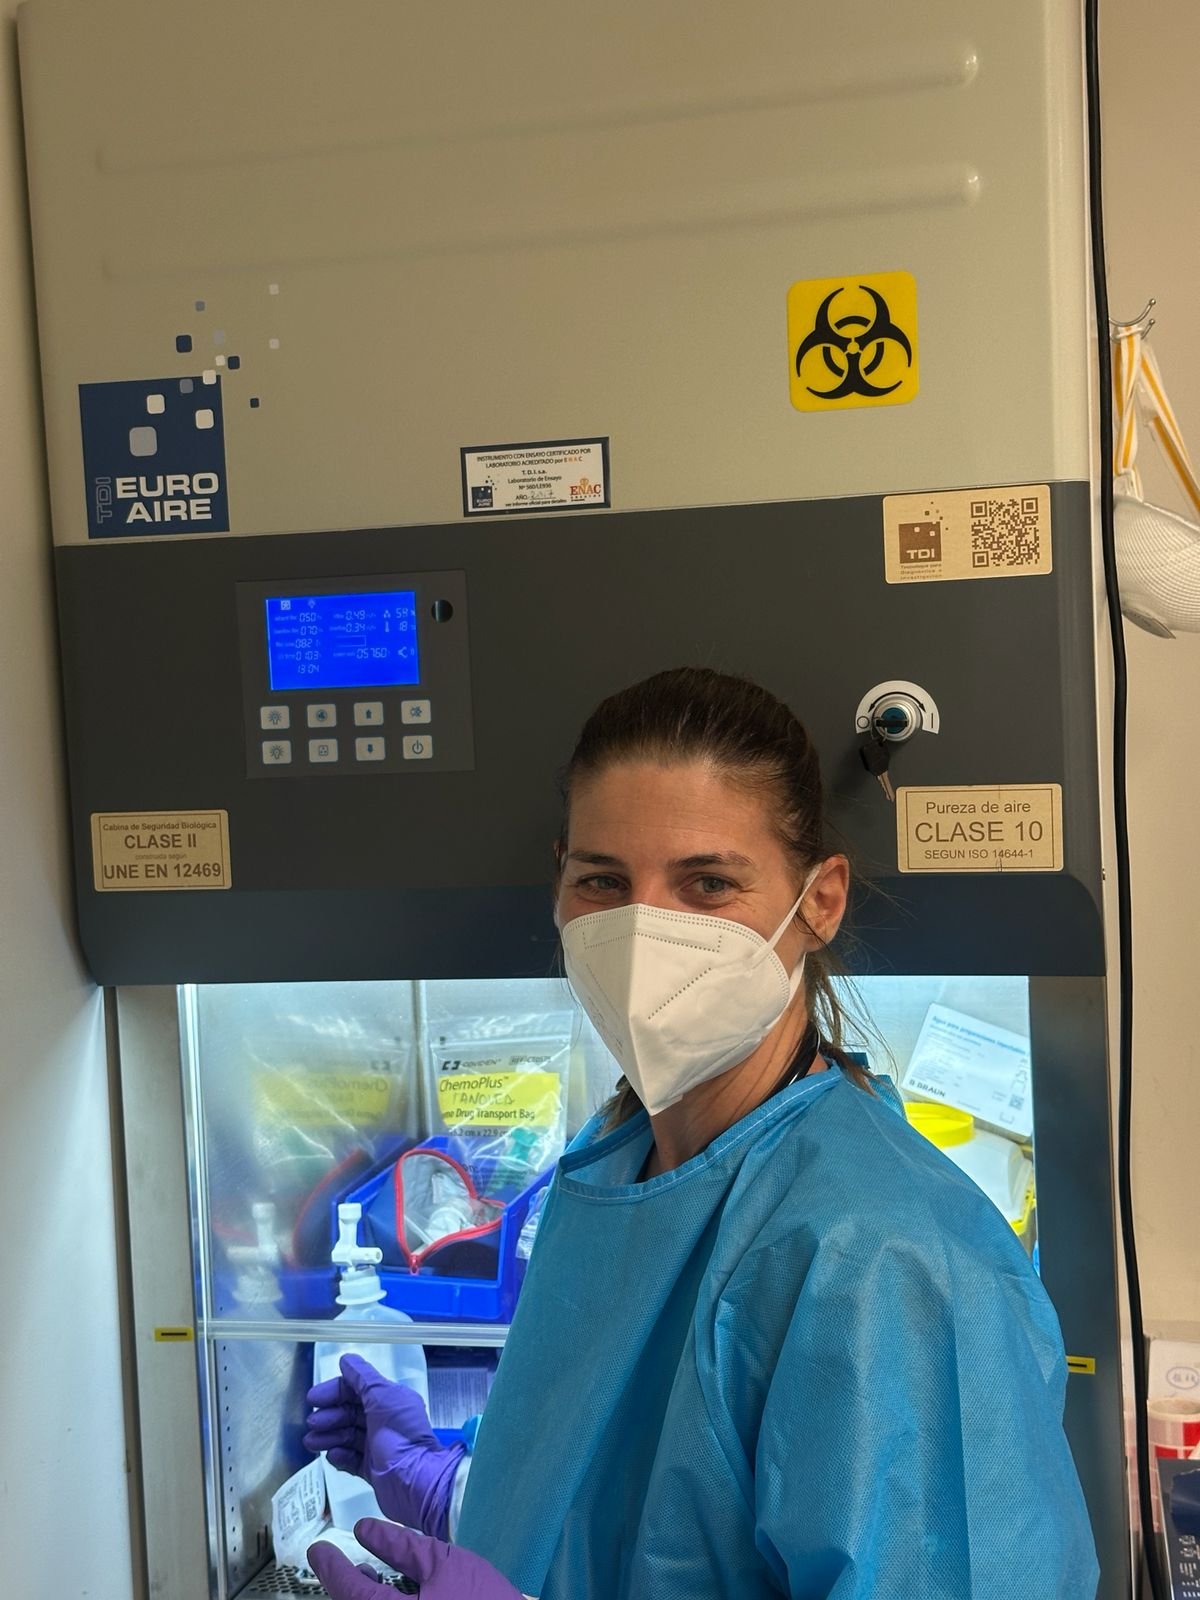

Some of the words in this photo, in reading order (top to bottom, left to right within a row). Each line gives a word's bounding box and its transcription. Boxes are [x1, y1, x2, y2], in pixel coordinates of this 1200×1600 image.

[477, 454, 513, 462] INSTRUMENTO
[485, 460, 521, 469] LABORATORIO
[521, 457, 554, 466] ACREDITADO
[115, 472, 219, 499] EURO
[570, 484, 602, 496] ENAC
[125, 498, 212, 523] AIRE
[906, 548, 935, 560] TDI
[345, 610, 366, 621] 0.49
[345, 622, 366, 633] 0.34
[295, 638, 313, 649] 082
[926, 801, 977, 815] Pureza
[981, 801, 1000, 814] de
[1004, 801, 1031, 813] aire
[102, 823, 129, 832] Cabina
[130, 823, 140, 831] de
[141, 822, 180, 832] Seguridad
[181, 821, 217, 832] Biológica
[914, 821, 1005, 844] CLASE
[1015, 820, 1043, 842] 10
[124, 834, 183, 850] CLASE
[187, 833, 197, 848] II
[924, 849, 966, 861] SEGUN
[968, 849, 989, 860] ISO
[992, 848, 1034, 860] 14644-1
[104, 864, 139, 880] UNE
[144, 863, 169, 879] EN
[173, 862, 221, 879] 12469
[916, 1082, 946, 1098] BRAUN
[455, 1108, 475, 1120] Drug
[477, 1108, 517, 1120] Transport
[519, 1110, 536, 1121] Bag
